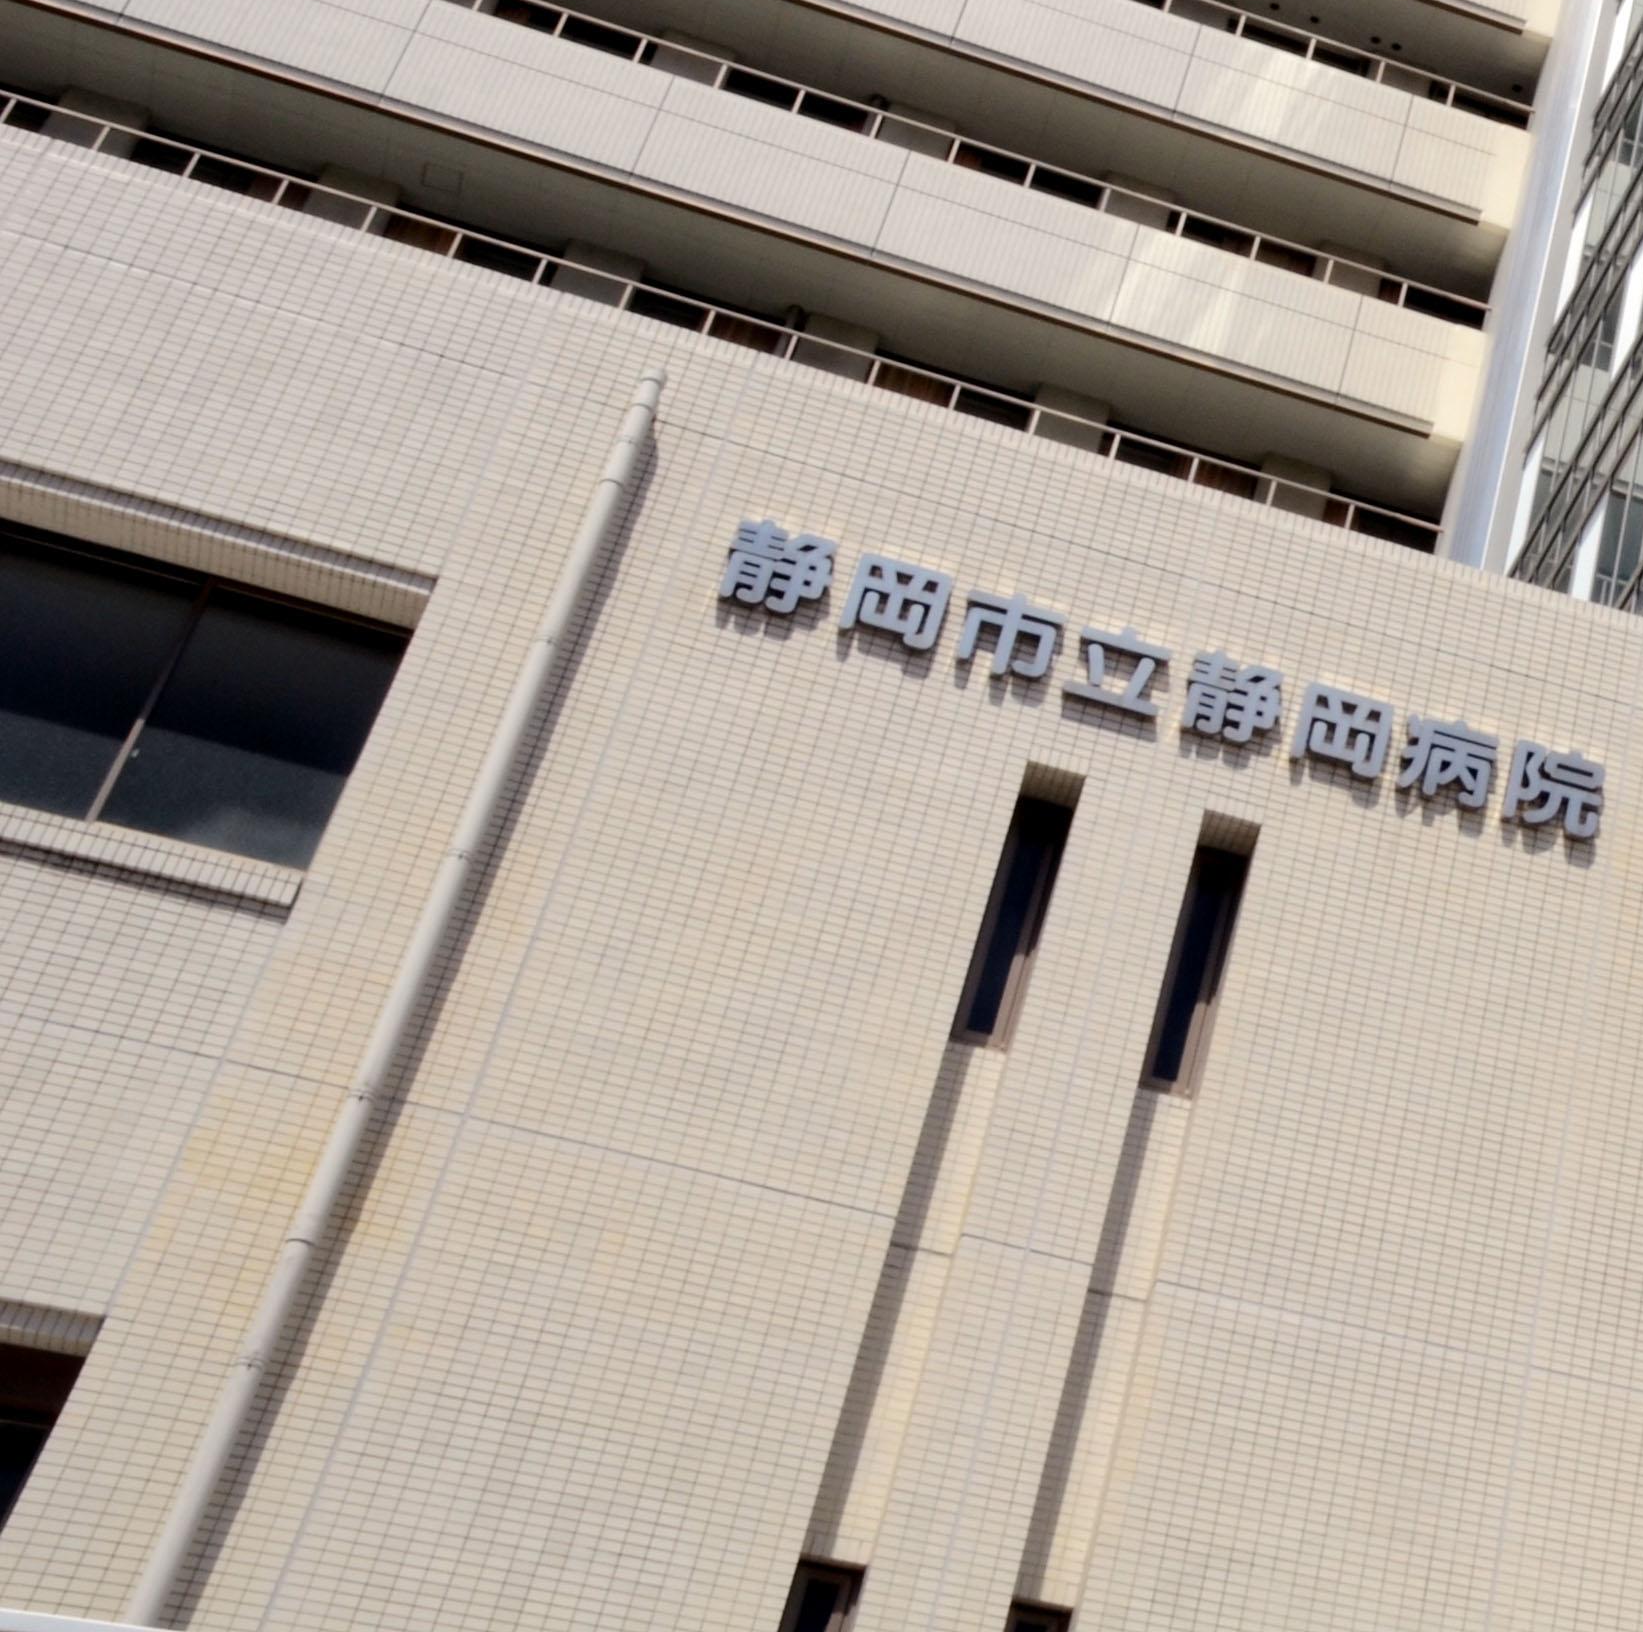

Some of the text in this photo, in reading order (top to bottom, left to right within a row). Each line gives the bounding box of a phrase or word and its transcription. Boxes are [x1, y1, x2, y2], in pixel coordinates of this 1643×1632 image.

[718, 519, 1606, 839] 静岡市立静岡病院
